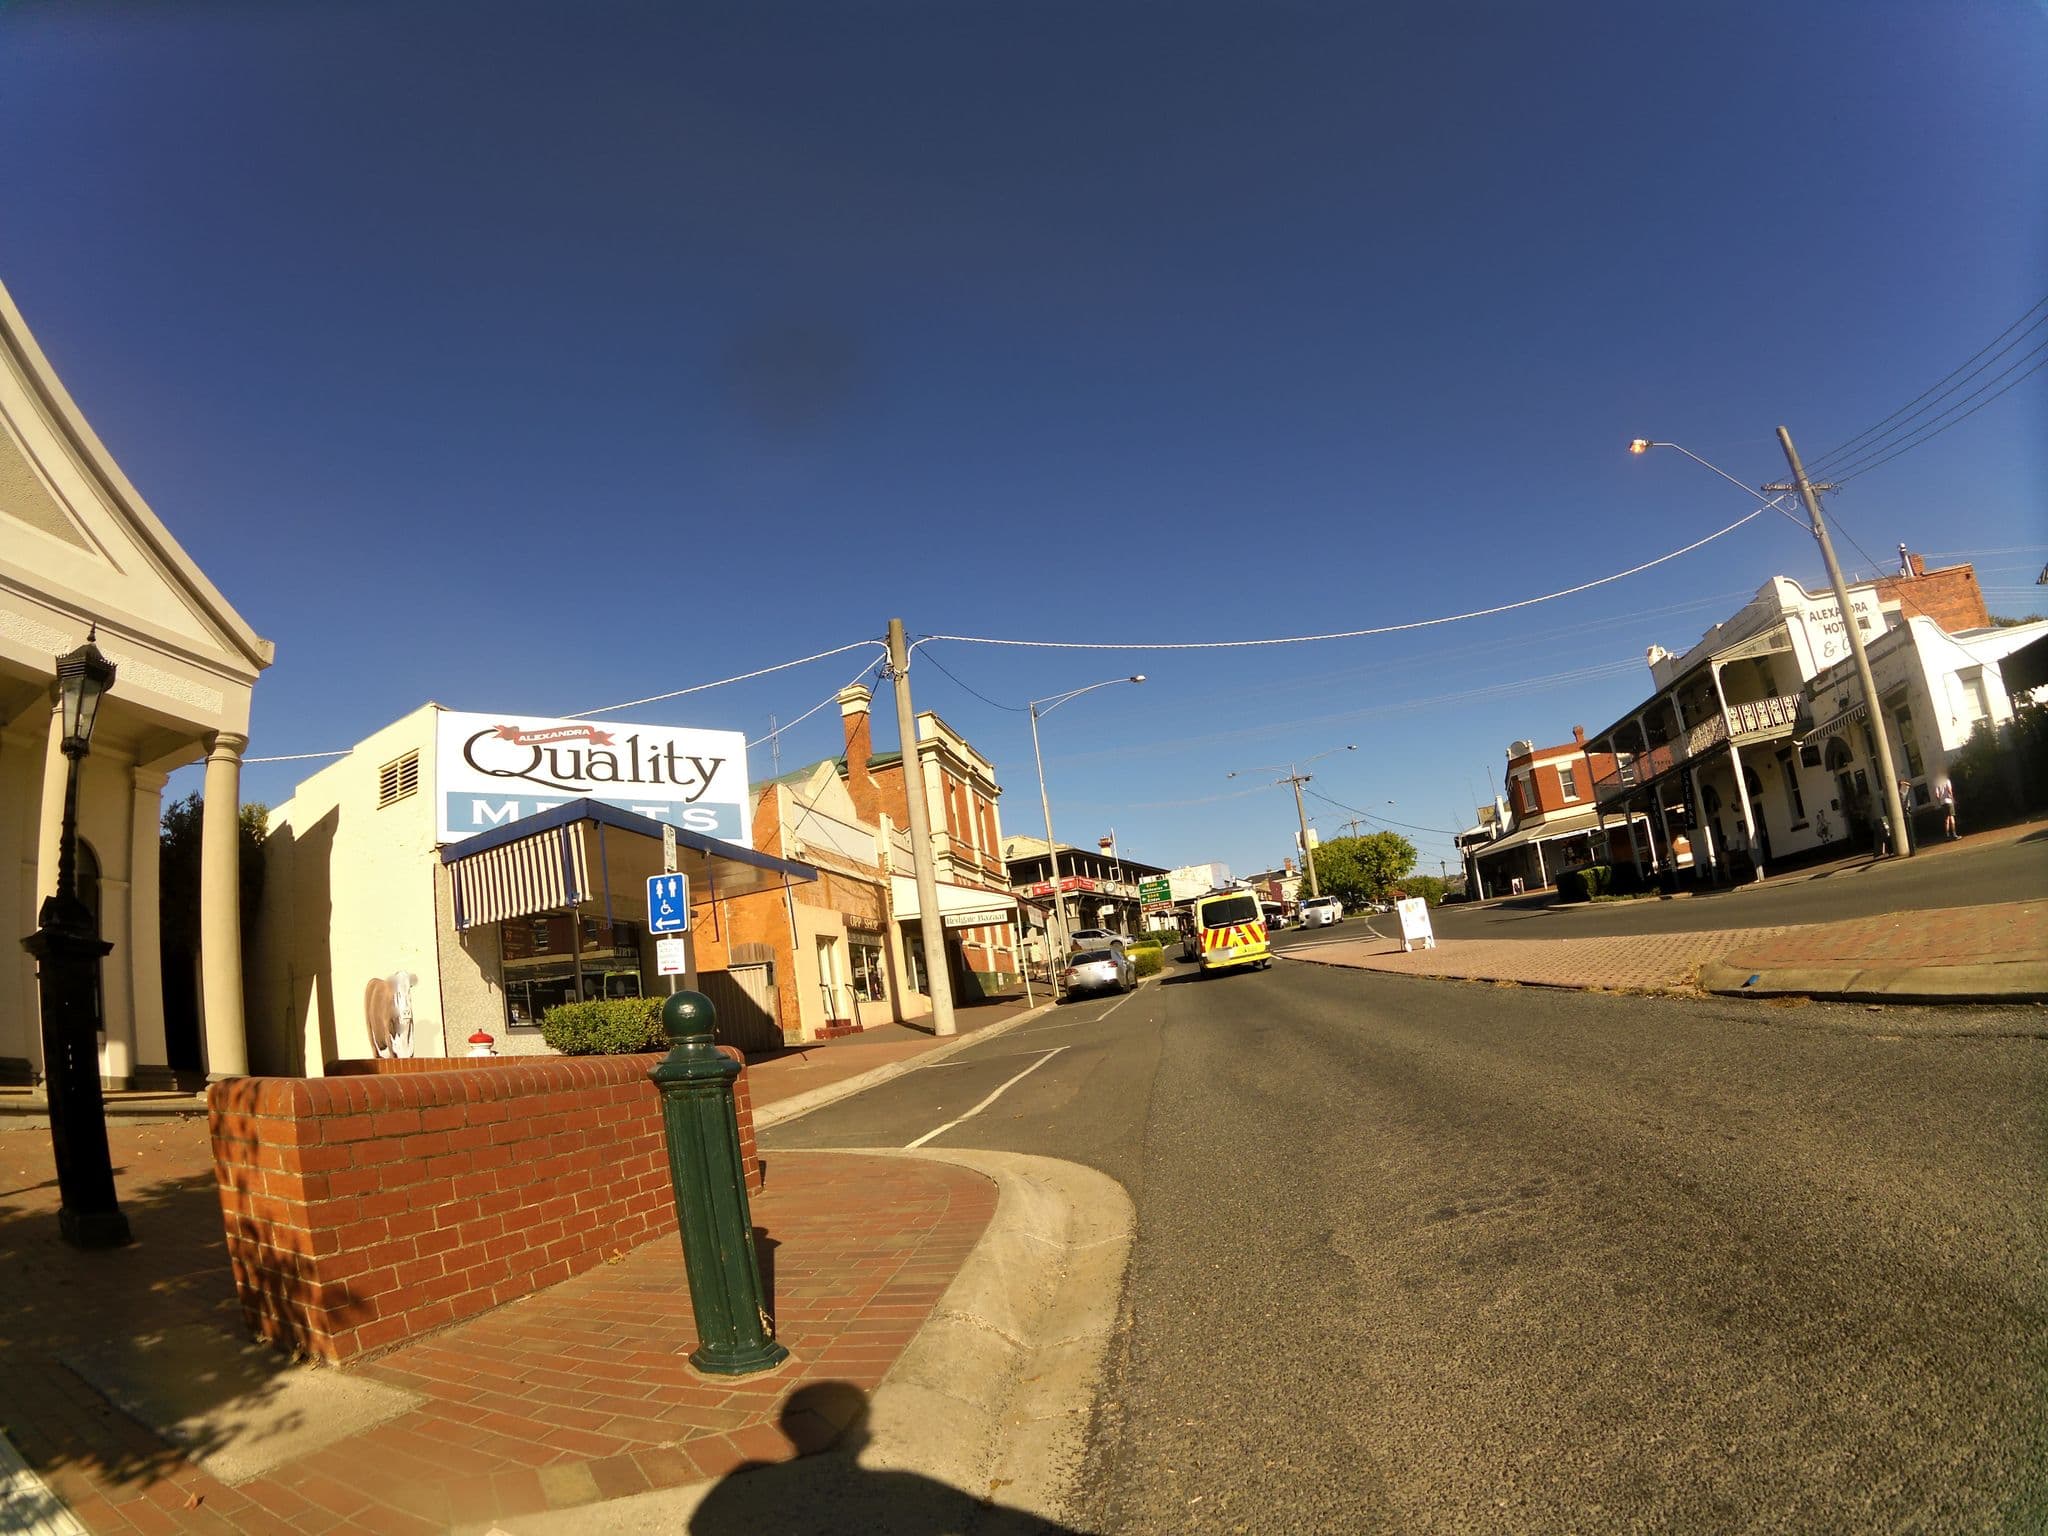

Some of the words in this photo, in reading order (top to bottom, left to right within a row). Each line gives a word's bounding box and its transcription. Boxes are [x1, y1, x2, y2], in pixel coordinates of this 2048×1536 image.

[518, 728, 591, 743] ALEXANDRA
[463, 728, 726, 803] Quality
[472, 799, 718, 832] MTS
